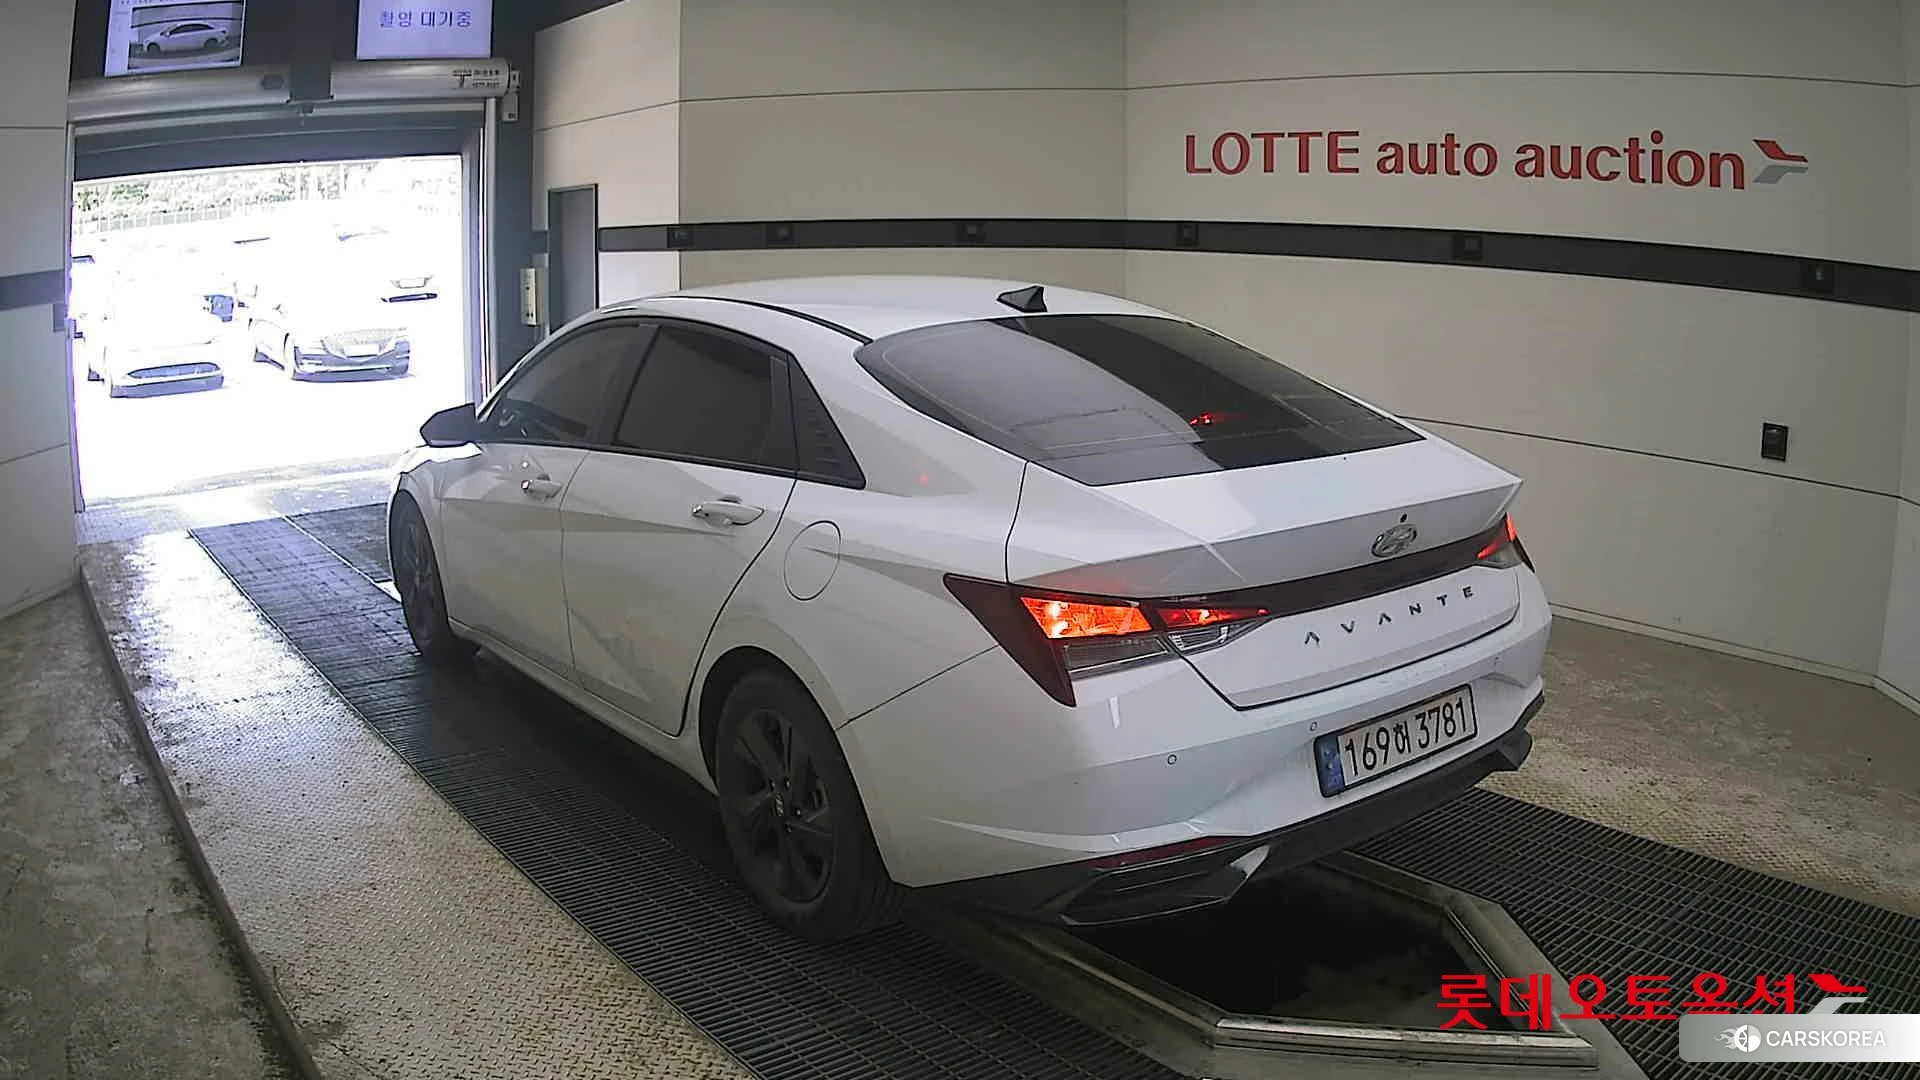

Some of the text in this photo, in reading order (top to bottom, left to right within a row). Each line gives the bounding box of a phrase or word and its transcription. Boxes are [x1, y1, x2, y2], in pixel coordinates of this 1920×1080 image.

[421, 9, 471, 28] 대기중
[1185, 130, 1745, 190] LOTTE auto auction
[1304, 586, 1474, 647] AVANTE
[1345, 697, 1466, 776] 169허 3781
